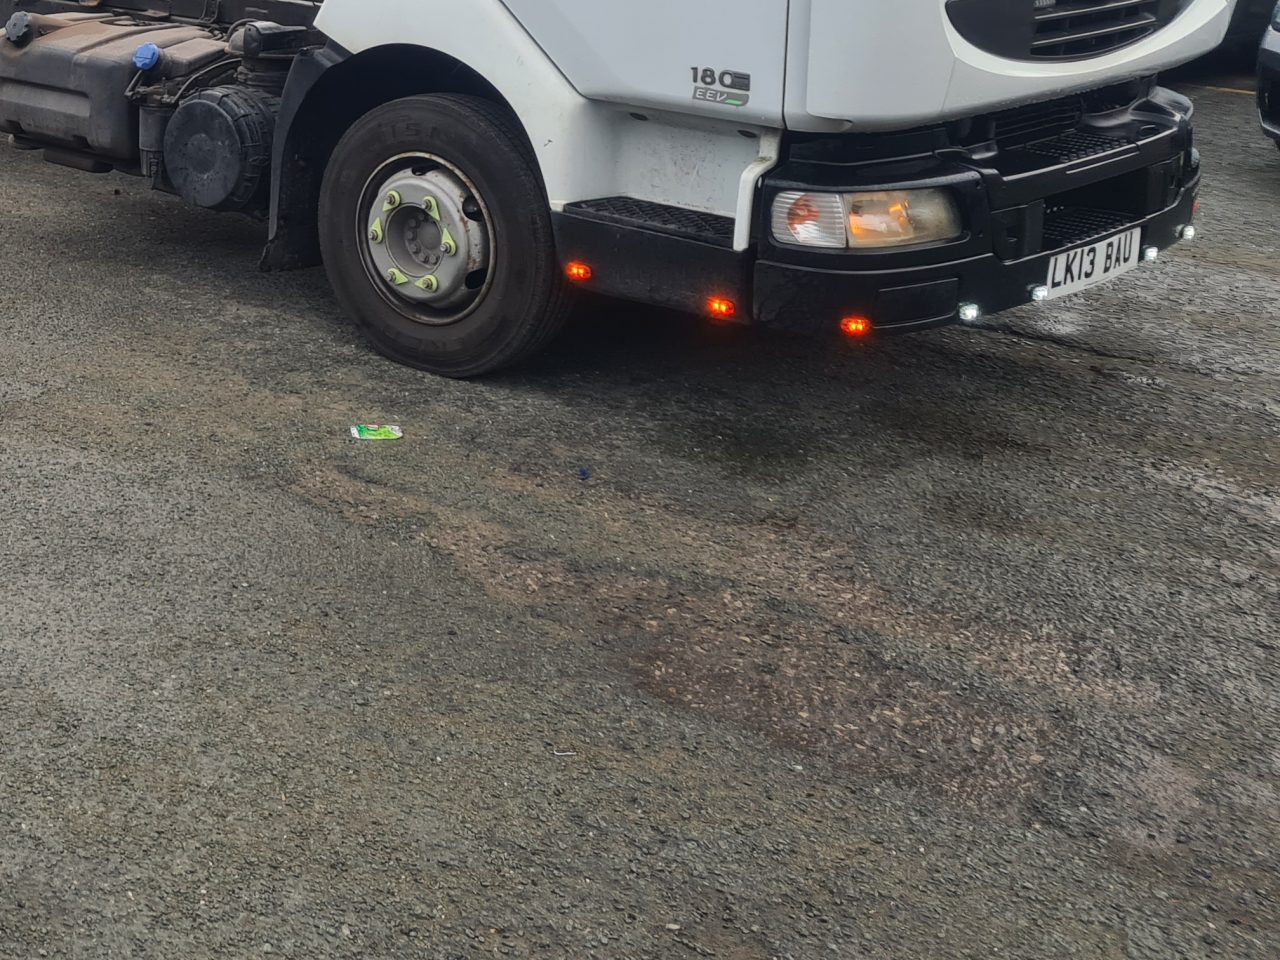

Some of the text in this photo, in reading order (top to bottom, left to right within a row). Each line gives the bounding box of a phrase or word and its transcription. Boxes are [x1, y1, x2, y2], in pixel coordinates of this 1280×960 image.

[695, 88, 728, 102] EEV
[1051, 231, 1133, 289] LK13 BAU
